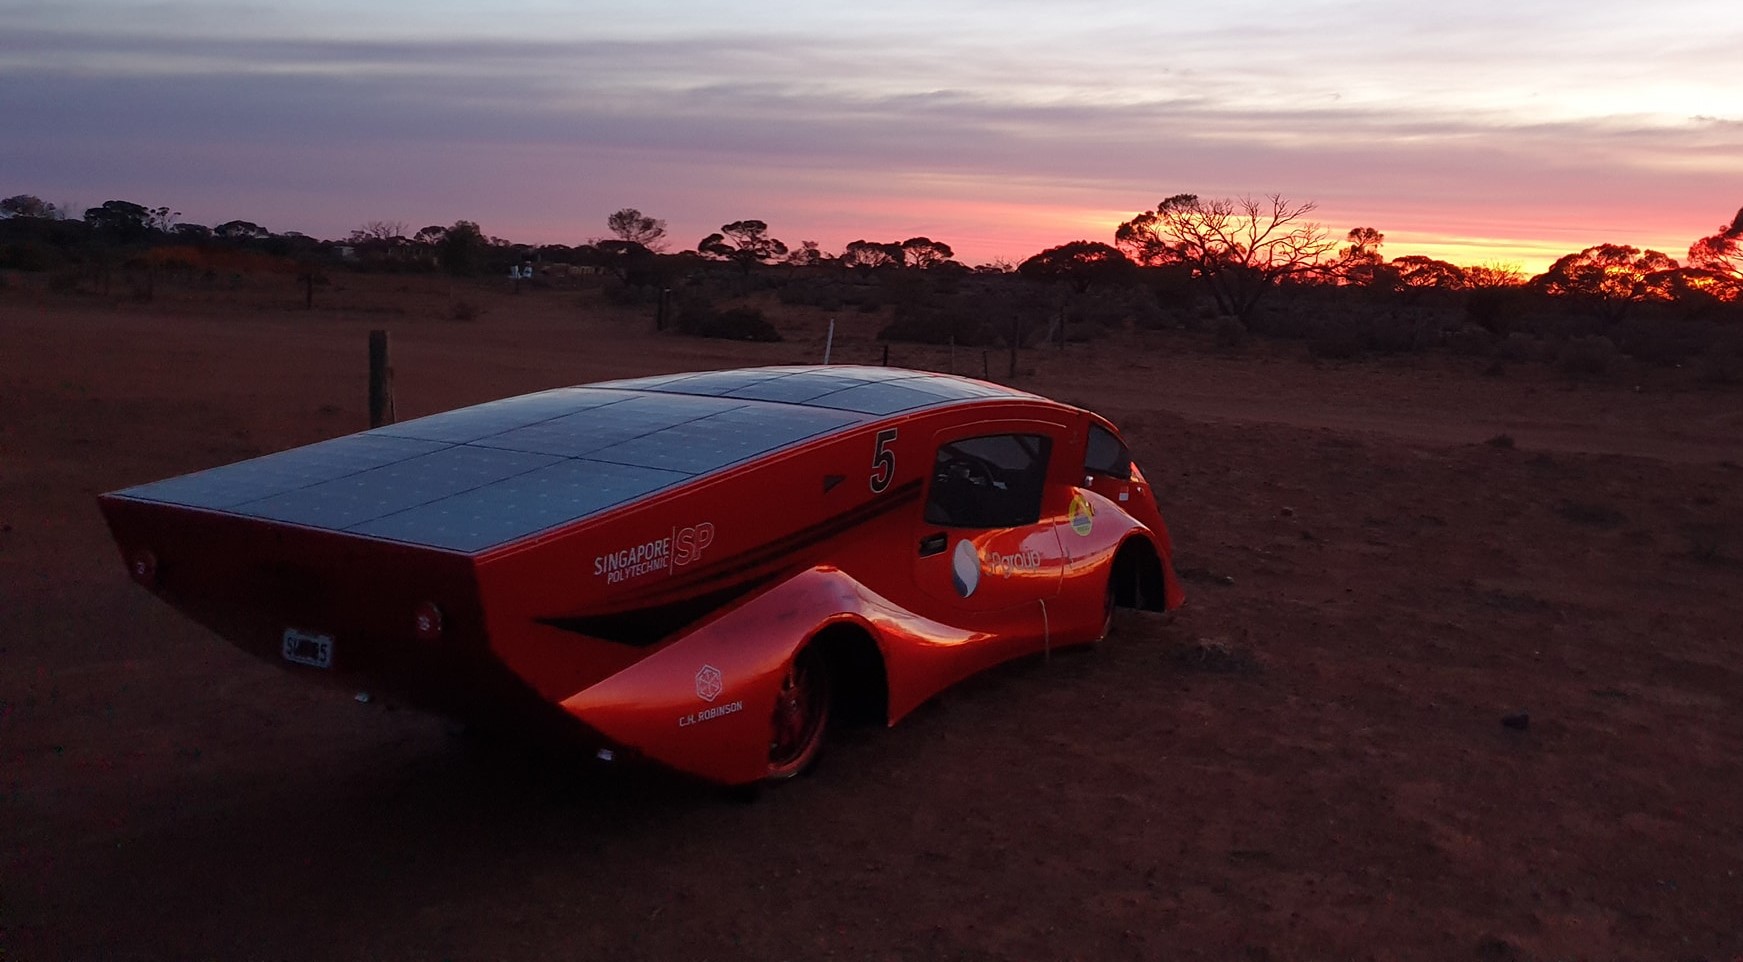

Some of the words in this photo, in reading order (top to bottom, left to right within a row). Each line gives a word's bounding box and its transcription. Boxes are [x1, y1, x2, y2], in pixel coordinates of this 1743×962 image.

[869, 427, 898, 494] 5
[593, 537, 671, 576] SINGAPORE
[674, 521, 715, 566] SP
[607, 555, 670, 585] POLYTECHNIC
[679, 714, 697, 728] C.H.
[698, 700, 743, 722] ROBINSON
